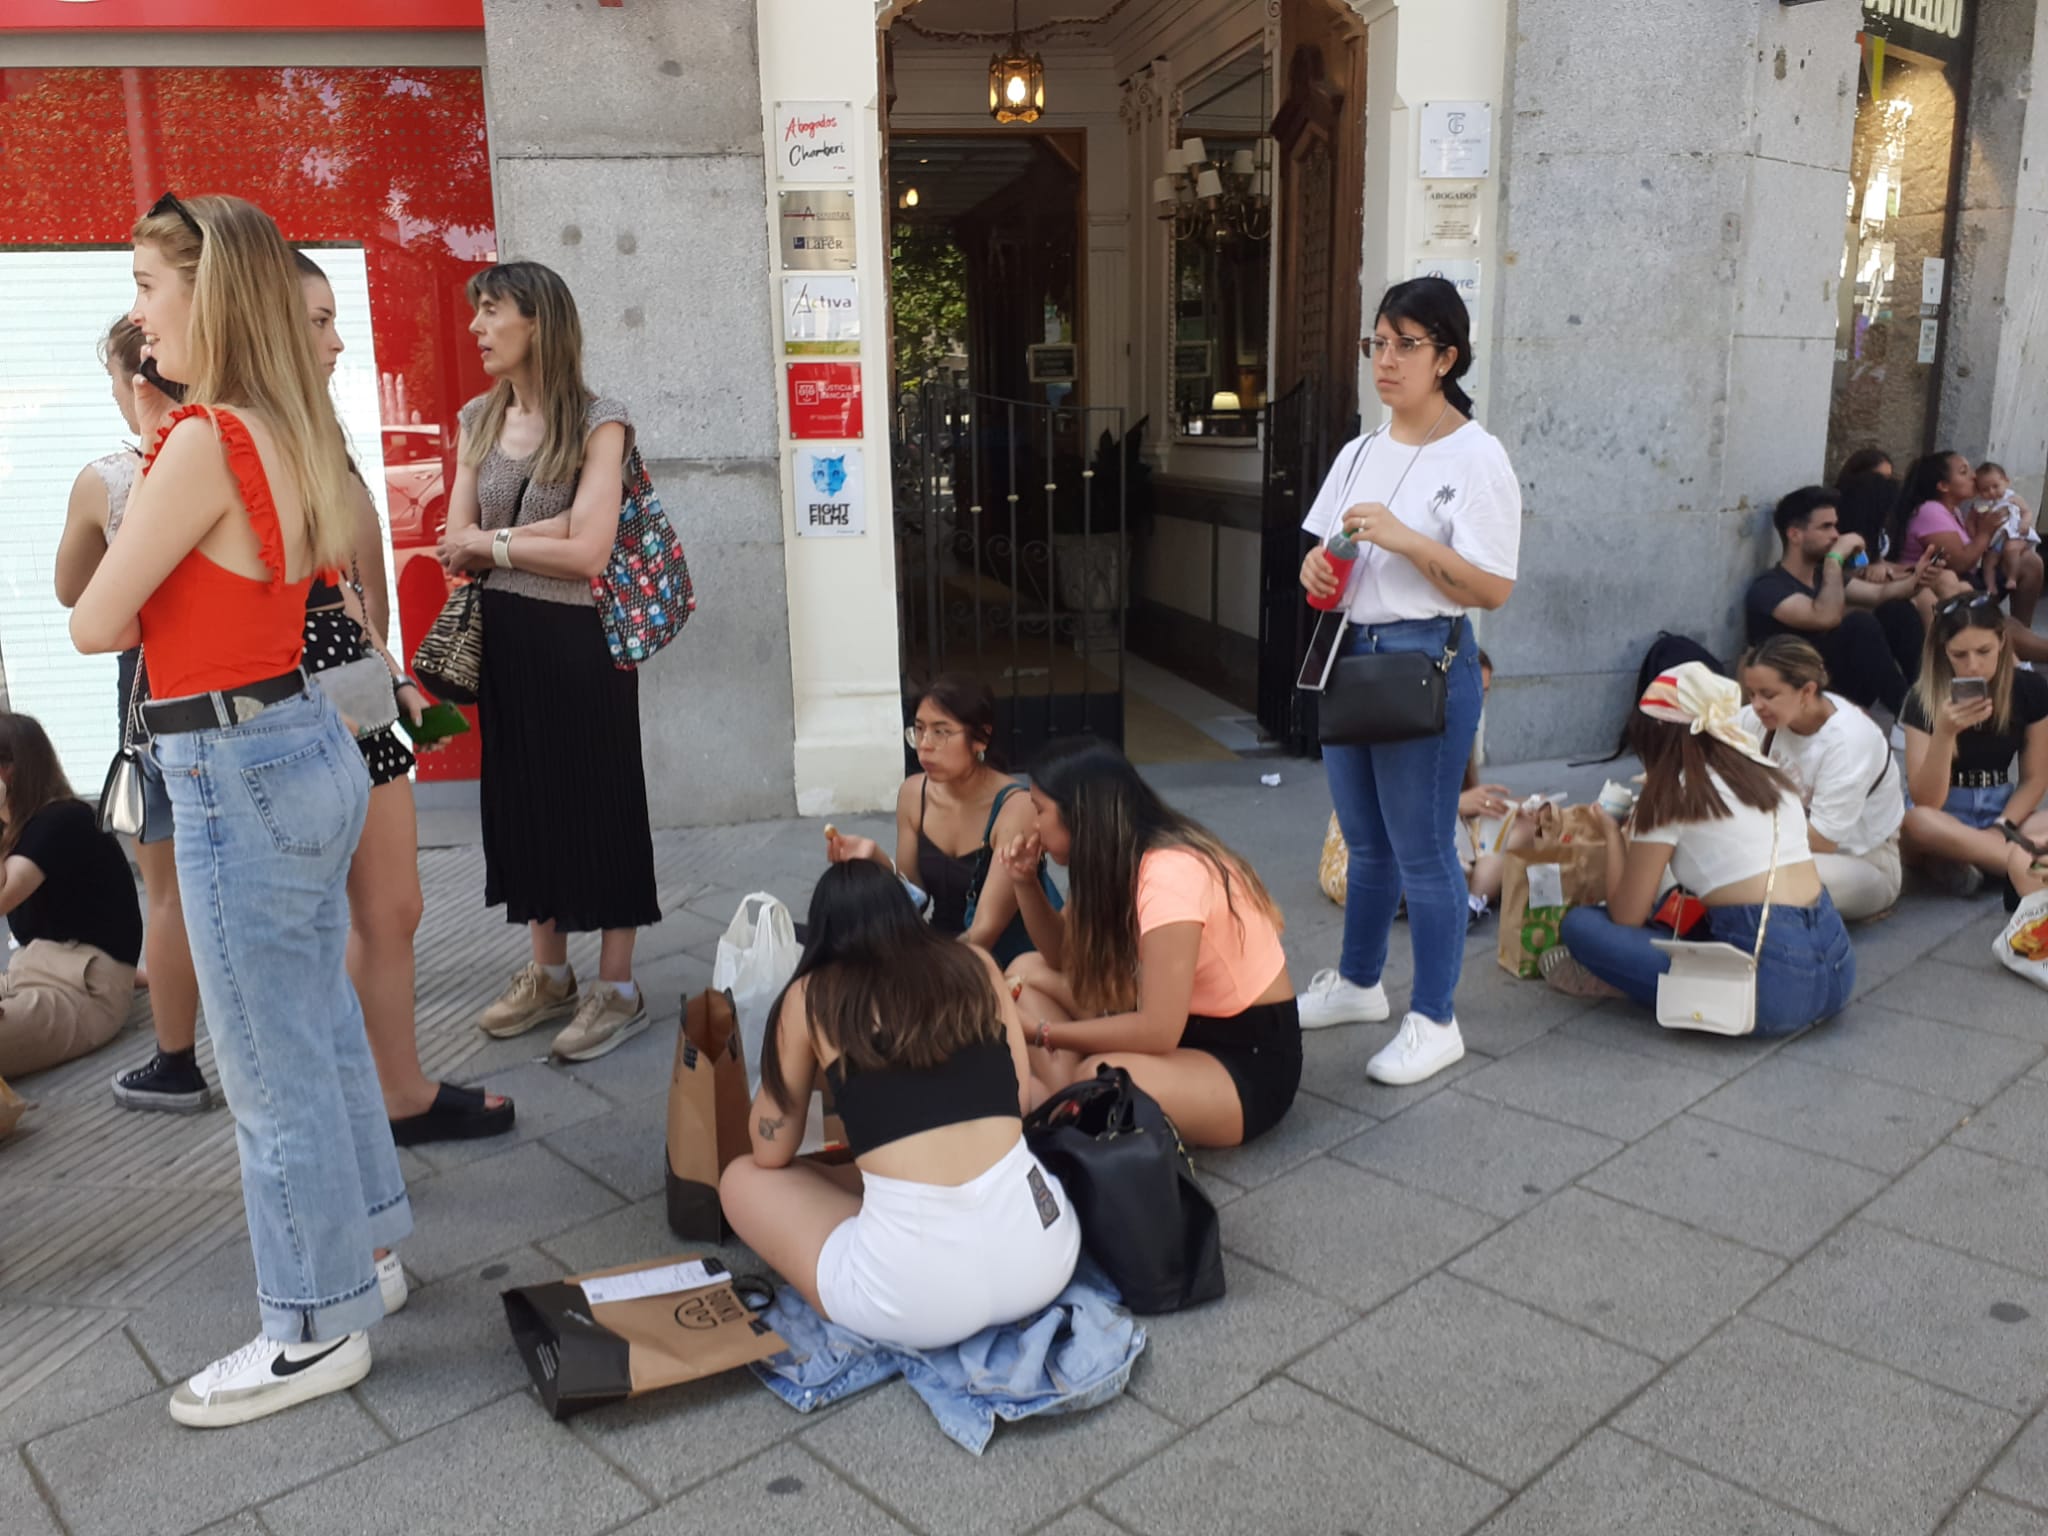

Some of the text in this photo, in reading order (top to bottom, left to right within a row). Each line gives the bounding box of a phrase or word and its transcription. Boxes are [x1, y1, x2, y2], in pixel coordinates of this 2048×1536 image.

[784, 113, 838, 142] Abogados
[1430, 191, 1477, 200] ABOGADOS
[791, 283, 852, 317] Activa
[808, 503, 850, 515] FIGHT
[809, 515, 849, 526] FILMS
